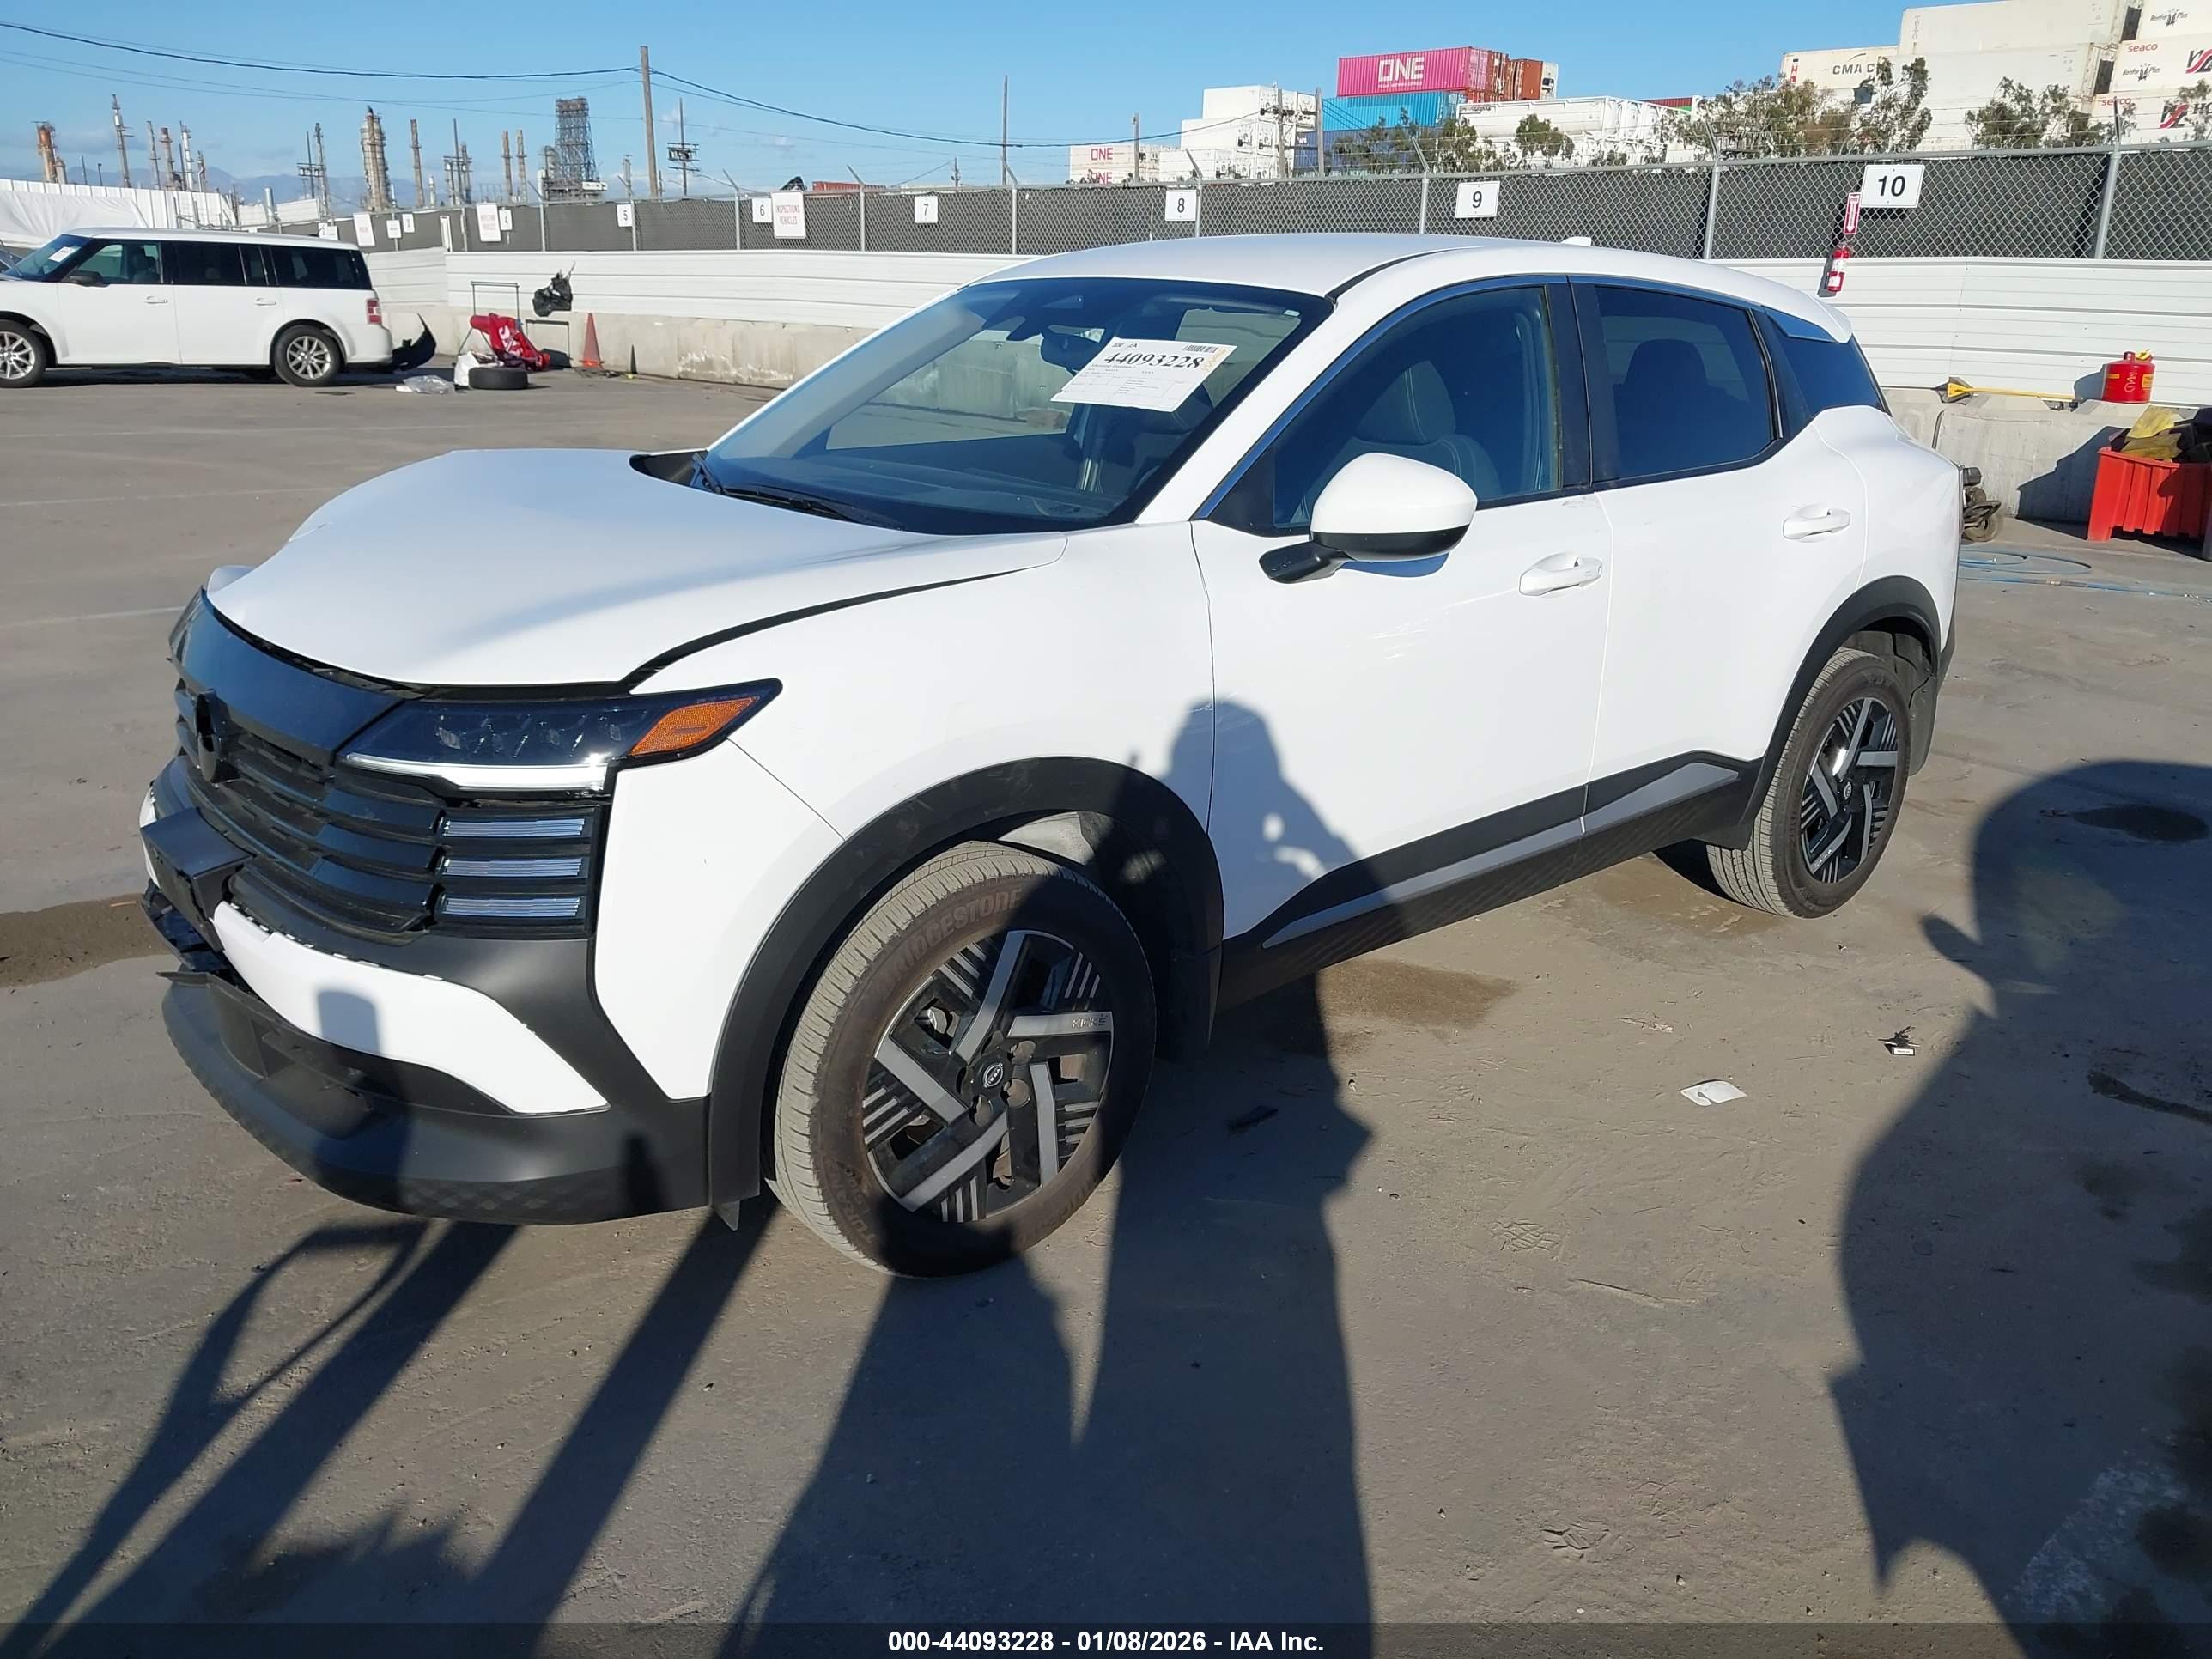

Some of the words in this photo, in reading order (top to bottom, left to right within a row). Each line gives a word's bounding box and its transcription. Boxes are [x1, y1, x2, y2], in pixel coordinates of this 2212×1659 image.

[2127, 42, 2159, 52] seaco
[1377, 56, 1425, 82] ONE
[1832, 63, 1863, 75] CMA
[1091, 147, 1114, 161] ONE
[1878, 175, 1906, 197] 10
[1176, 198, 1185, 213] 8
[1472, 191, 1482, 208] 9
[623, 210, 629, 221] 5
[759, 204, 765, 216] 6
[923, 203, 929, 216] 7
[1103, 351, 1205, 369] 44093228
